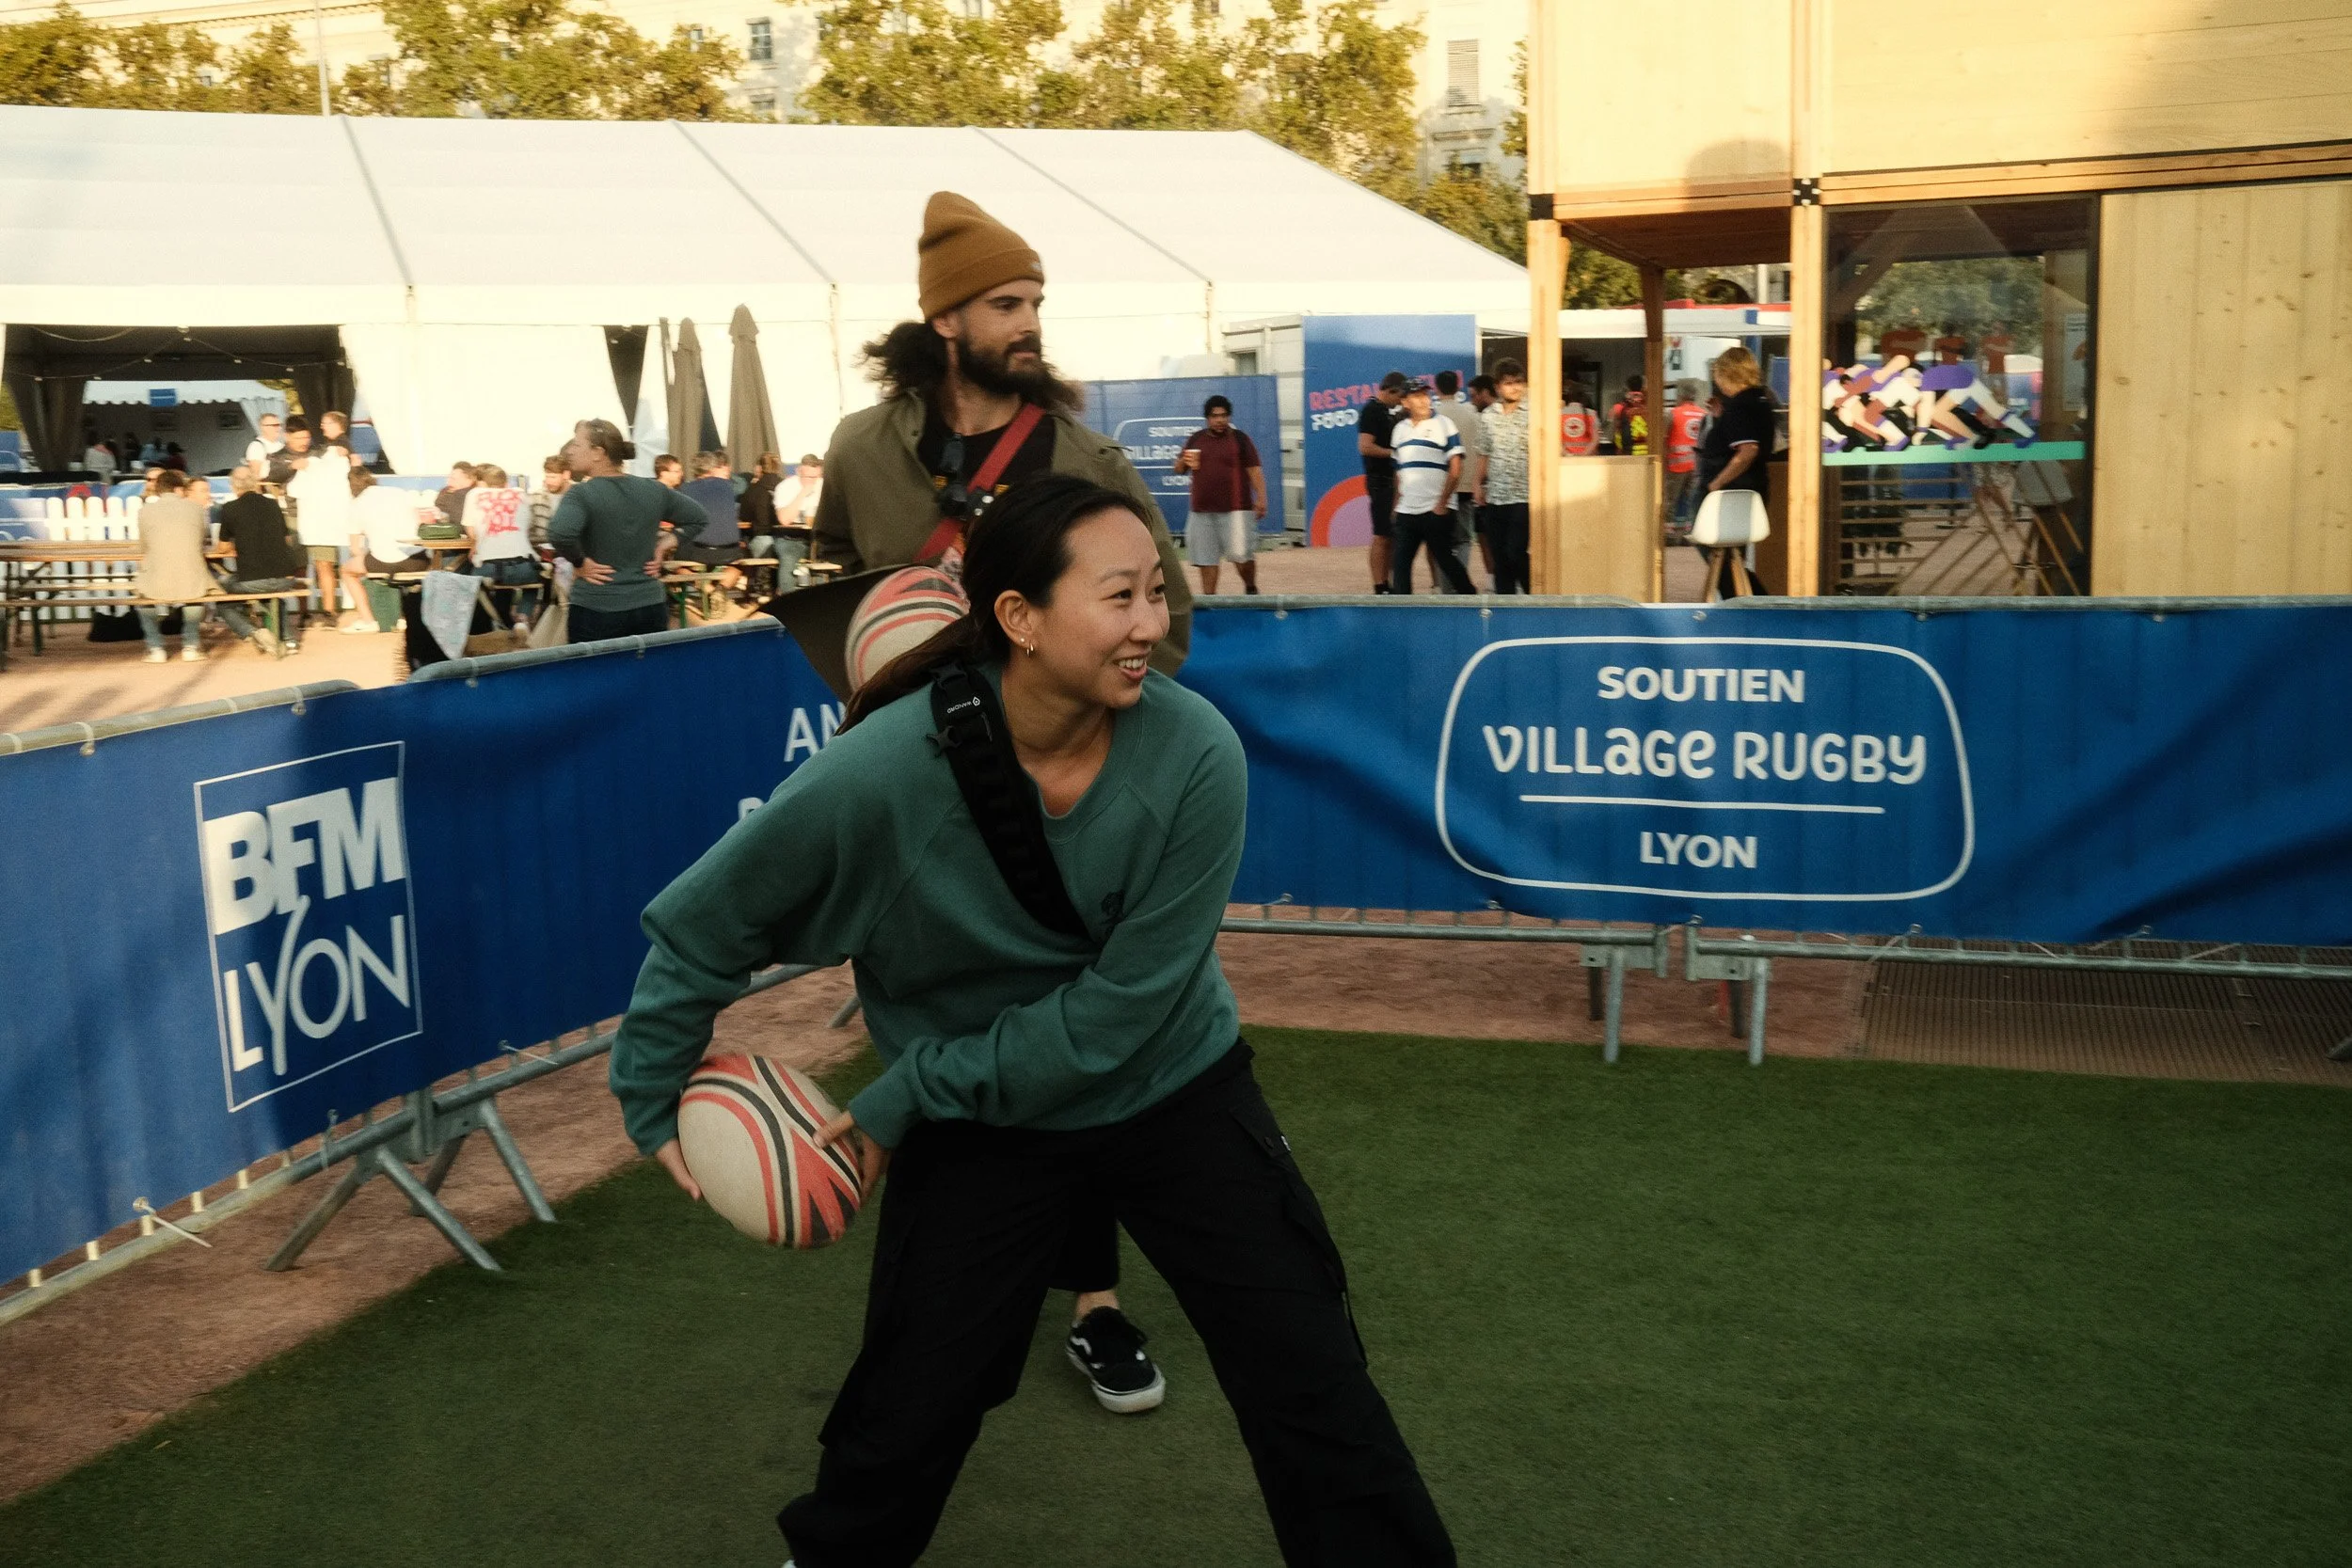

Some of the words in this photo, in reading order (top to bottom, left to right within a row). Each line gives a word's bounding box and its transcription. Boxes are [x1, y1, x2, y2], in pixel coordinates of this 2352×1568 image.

[1148, 425, 1203, 437] SOUTIE
[1597, 665, 1805, 704] SOUTIEN
[202, 777, 406, 935] BFM
[1640, 832, 1758, 869] LYON
[224, 895, 411, 1076] LYON
